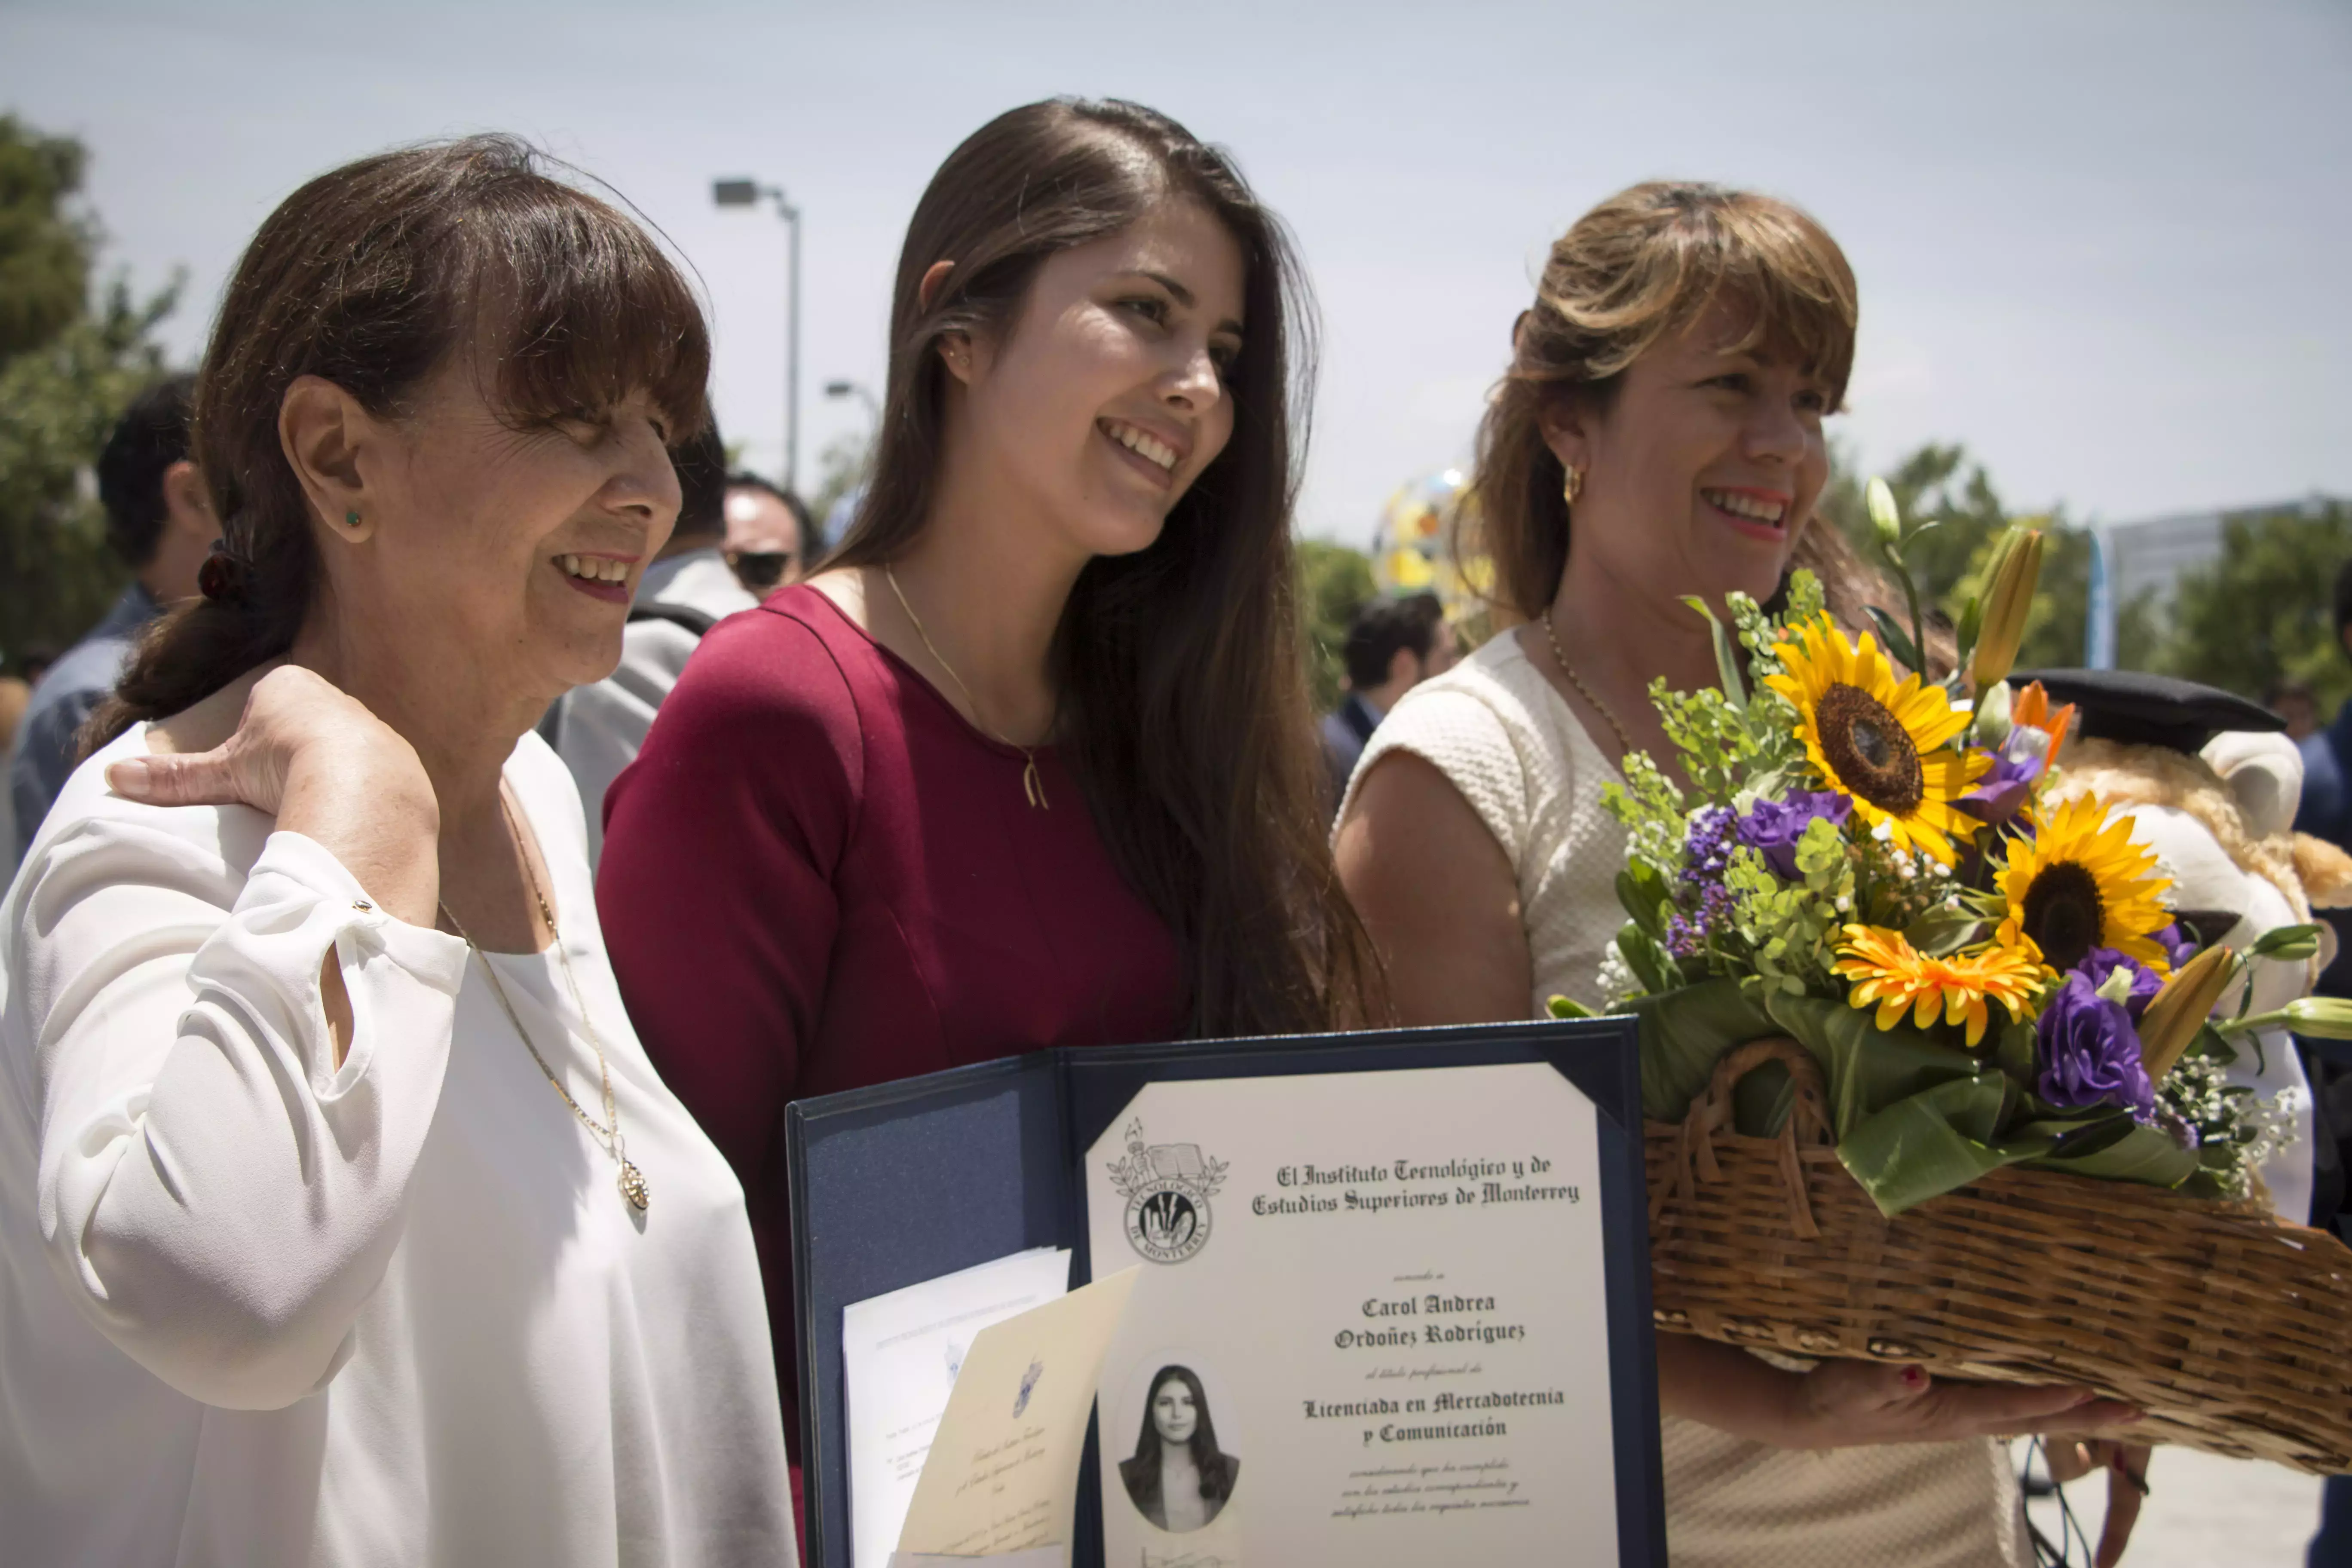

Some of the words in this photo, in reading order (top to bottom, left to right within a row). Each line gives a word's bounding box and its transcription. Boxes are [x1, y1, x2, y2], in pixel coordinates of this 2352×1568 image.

[1277, 1165, 1297, 1186] El
[1301, 1164, 1387, 1185] Instituto
[1395, 1158, 1506, 1181] Tecnológico
[1513, 1161, 1524, 1179] y
[1531, 1155, 1551, 1173] de
[1252, 1194, 1338, 1216] Estudios
[1344, 1189, 1448, 1213] Superiores
[1456, 1187, 1475, 1204] de
[1481, 1182, 1580, 1204] Monterrey
[1362, 1296, 1417, 1317] Carol
[1424, 1294, 1495, 1314] Andrea
[1335, 1327, 1417, 1348] Ordoñez
[1425, 1320, 1525, 1343] Rodríguez
[1303, 1398, 1399, 1418] Licenciada
[1406, 1399, 1425, 1412] en
[1433, 1387, 1564, 1413] Mercadotecnia
[1380, 1415, 1507, 1442] Comunicación
